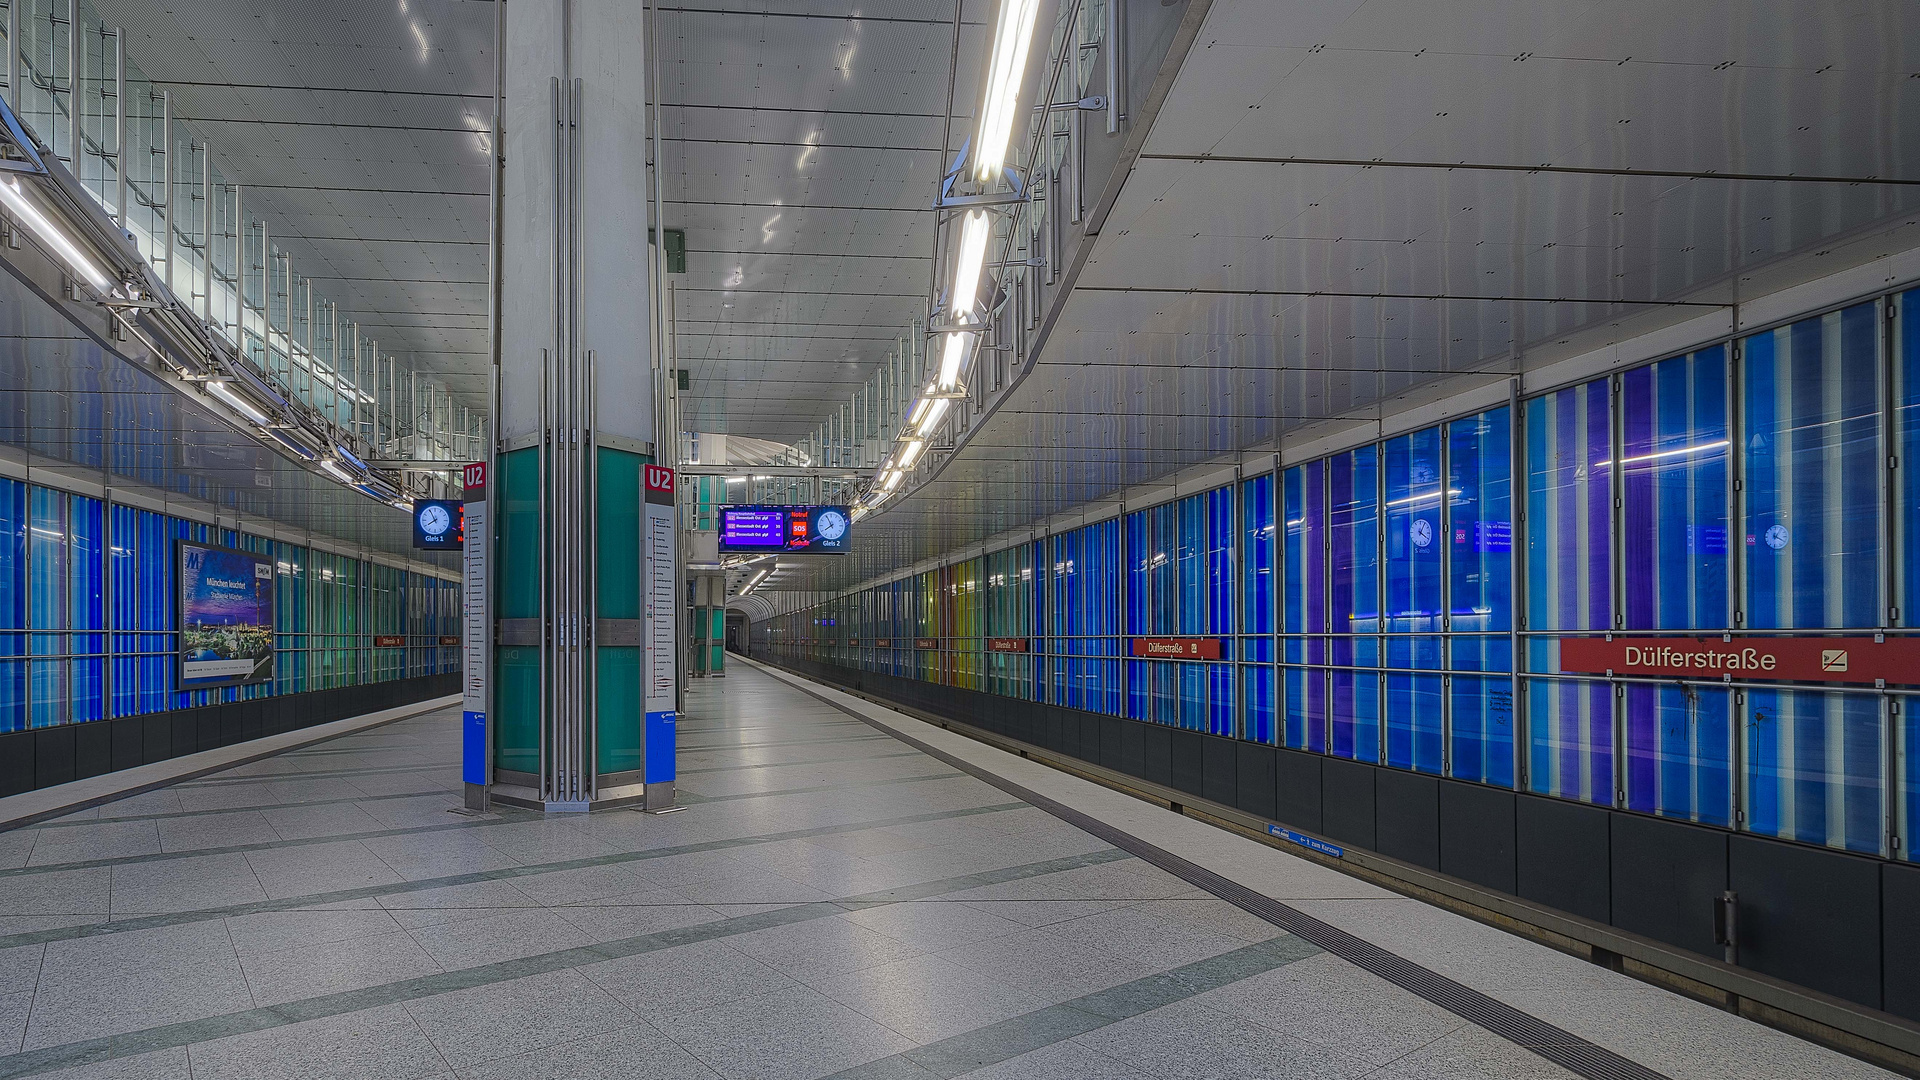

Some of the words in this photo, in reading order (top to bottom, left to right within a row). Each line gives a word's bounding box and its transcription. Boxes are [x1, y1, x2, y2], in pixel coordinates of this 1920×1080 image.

[466, 466, 483, 486] U2
[649, 468, 671, 489] U2
[206, 577, 228, 587] München
[228, 579, 246, 590] leuchtet
[1148, 642, 1183, 654] Dülferstraße
[1625, 646, 1776, 671] Dülferstraße
[1311, 841, 1321, 849] zum
[1321, 843, 1340, 857] Kurzzug
